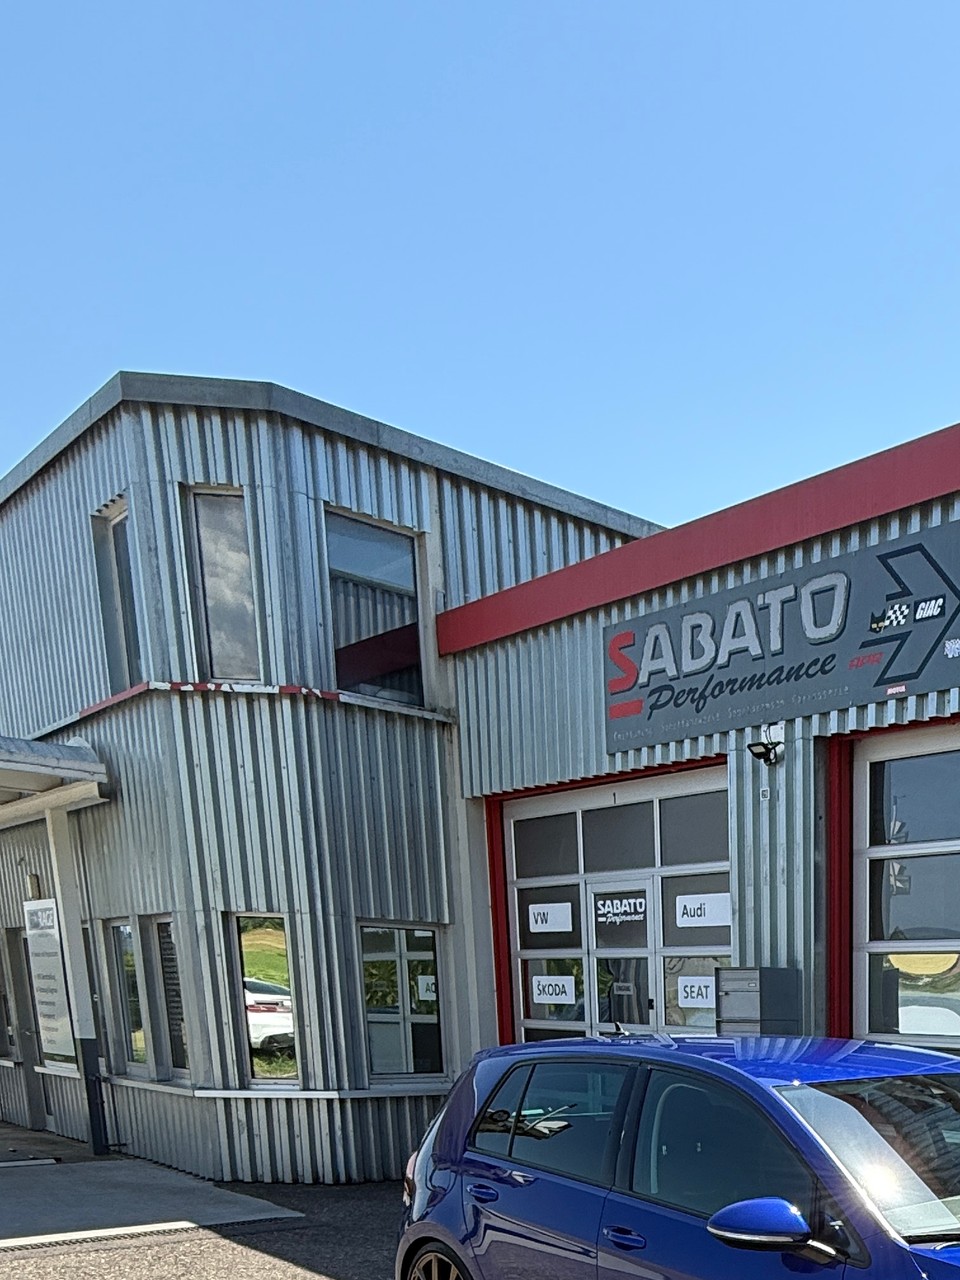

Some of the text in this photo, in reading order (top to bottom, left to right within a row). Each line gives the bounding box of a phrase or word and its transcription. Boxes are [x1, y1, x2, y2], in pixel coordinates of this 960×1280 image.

[915, 597, 944, 620] GIAC
[608, 572, 850, 695] SABATO
[647, 653, 836, 720] Performance
[597, 897, 646, 914] SABATO
[681, 902, 706, 918] Audi
[533, 911, 549, 925] VW
[536, 980, 567, 997] ŠKODA
[683, 984, 710, 1000] SEAT
